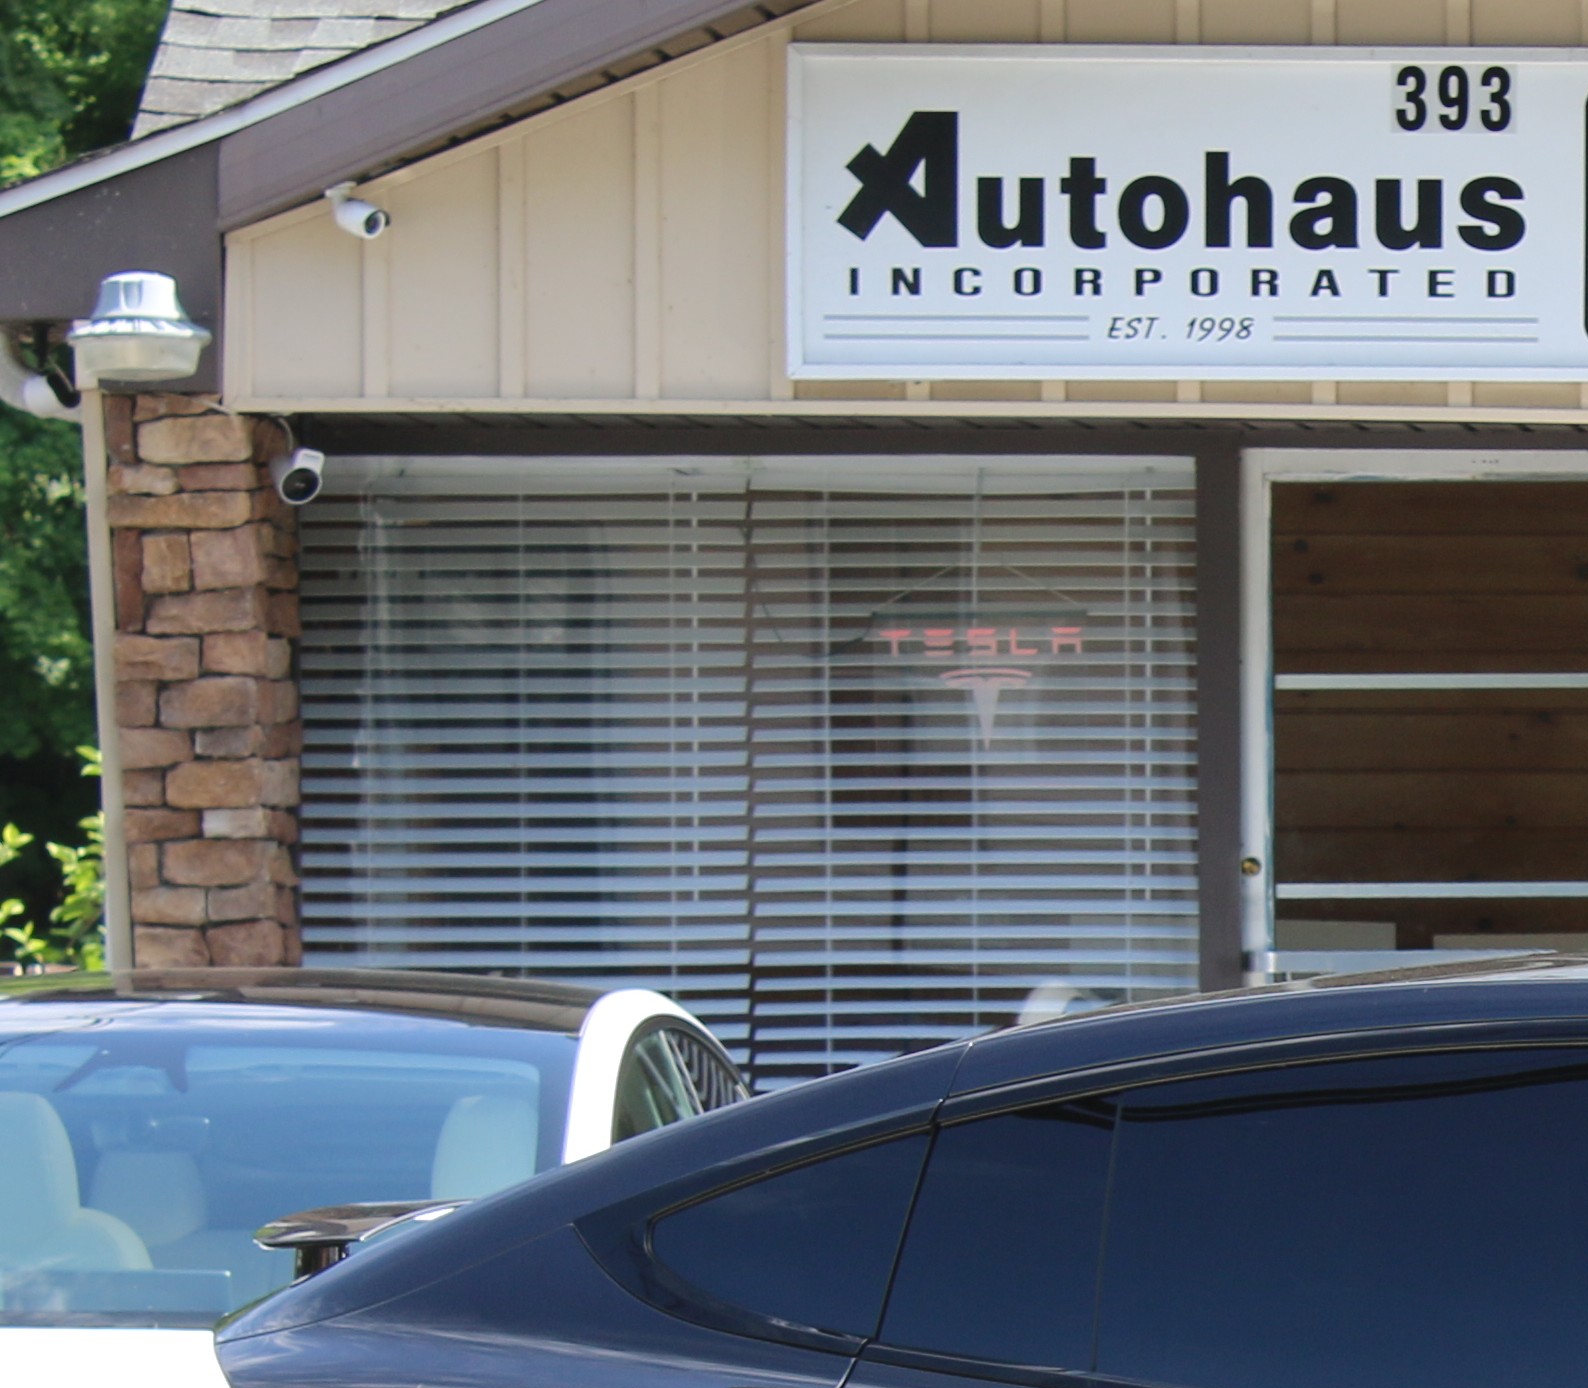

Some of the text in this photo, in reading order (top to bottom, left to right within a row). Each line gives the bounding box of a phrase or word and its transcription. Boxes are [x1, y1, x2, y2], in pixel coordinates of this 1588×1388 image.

[1395, 65, 1512, 132] 393
[836, 111, 1526, 252] Autohaus
[850, 267, 1515, 298] INCORPORATED
[1107, 316, 1255, 342] EST. 1998
[880, 626, 1083, 657] TESLA
